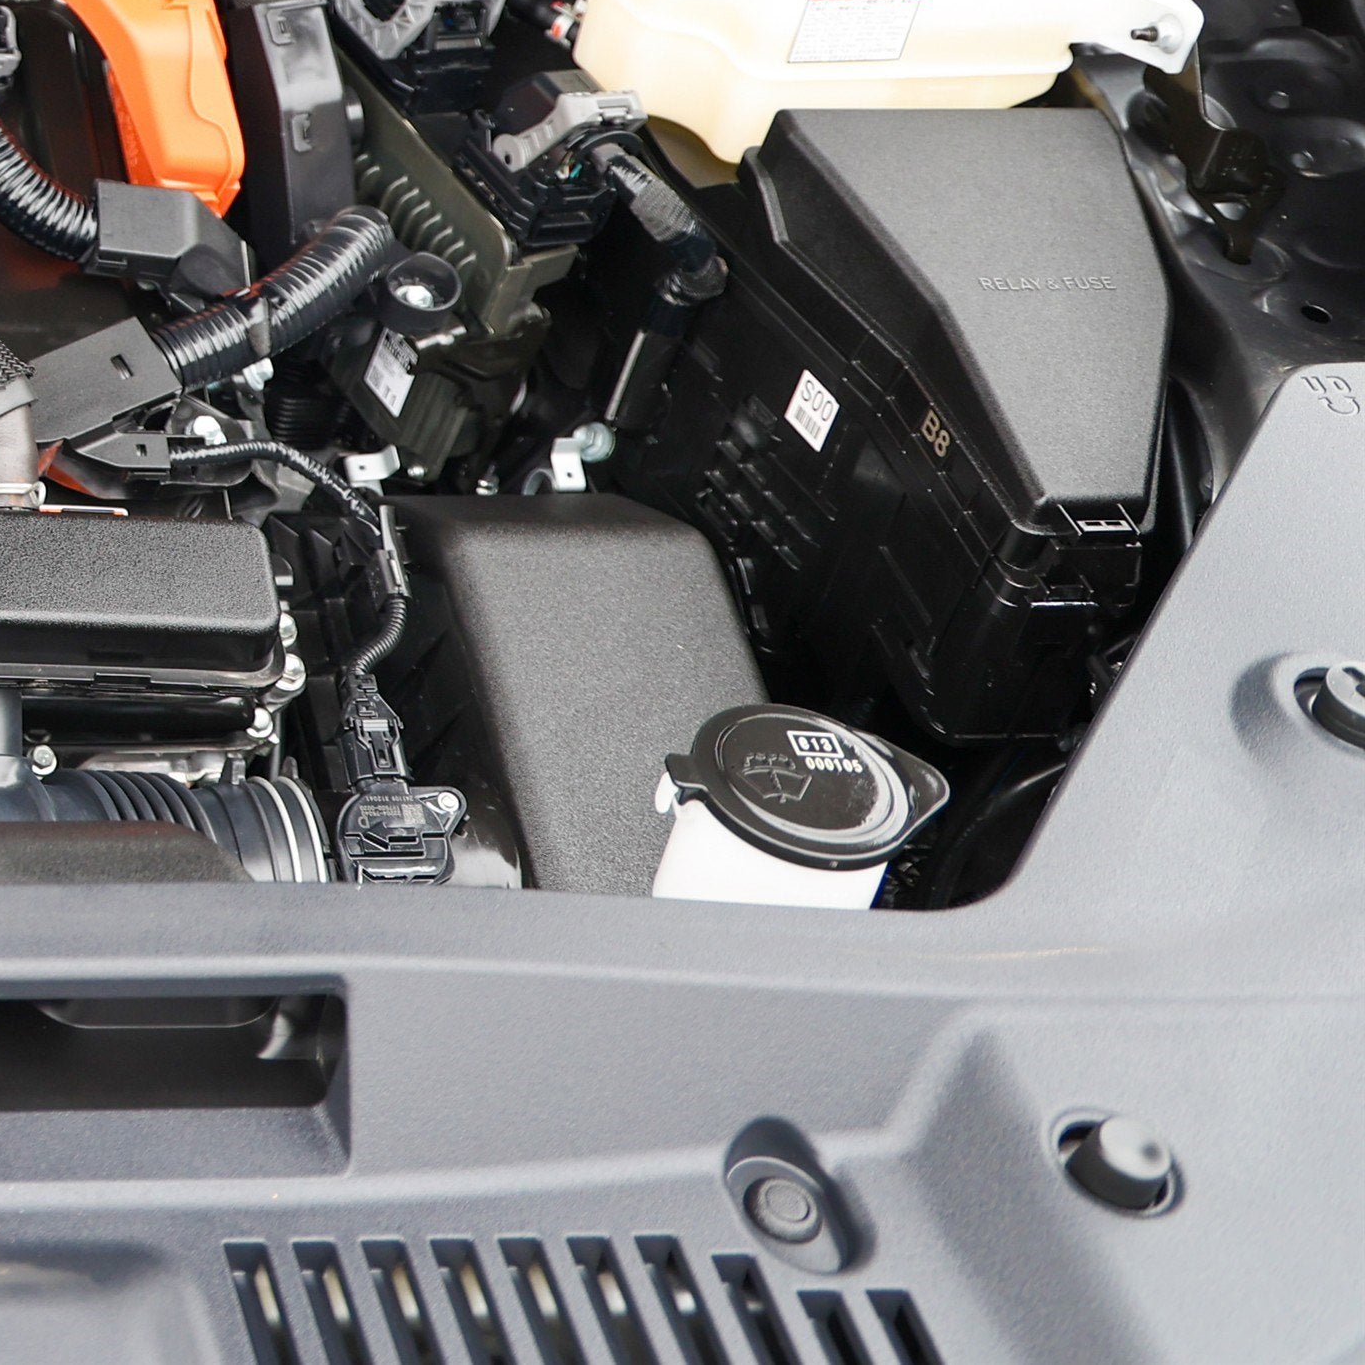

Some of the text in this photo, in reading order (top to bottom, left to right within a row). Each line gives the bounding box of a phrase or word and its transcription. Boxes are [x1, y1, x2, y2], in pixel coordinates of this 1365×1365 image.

[978, 276, 1118, 291] RELAY & FUSE
[1300, 375, 1352, 394] UP
[920, 409, 951, 458] B8
[805, 757, 863, 773] 000105
